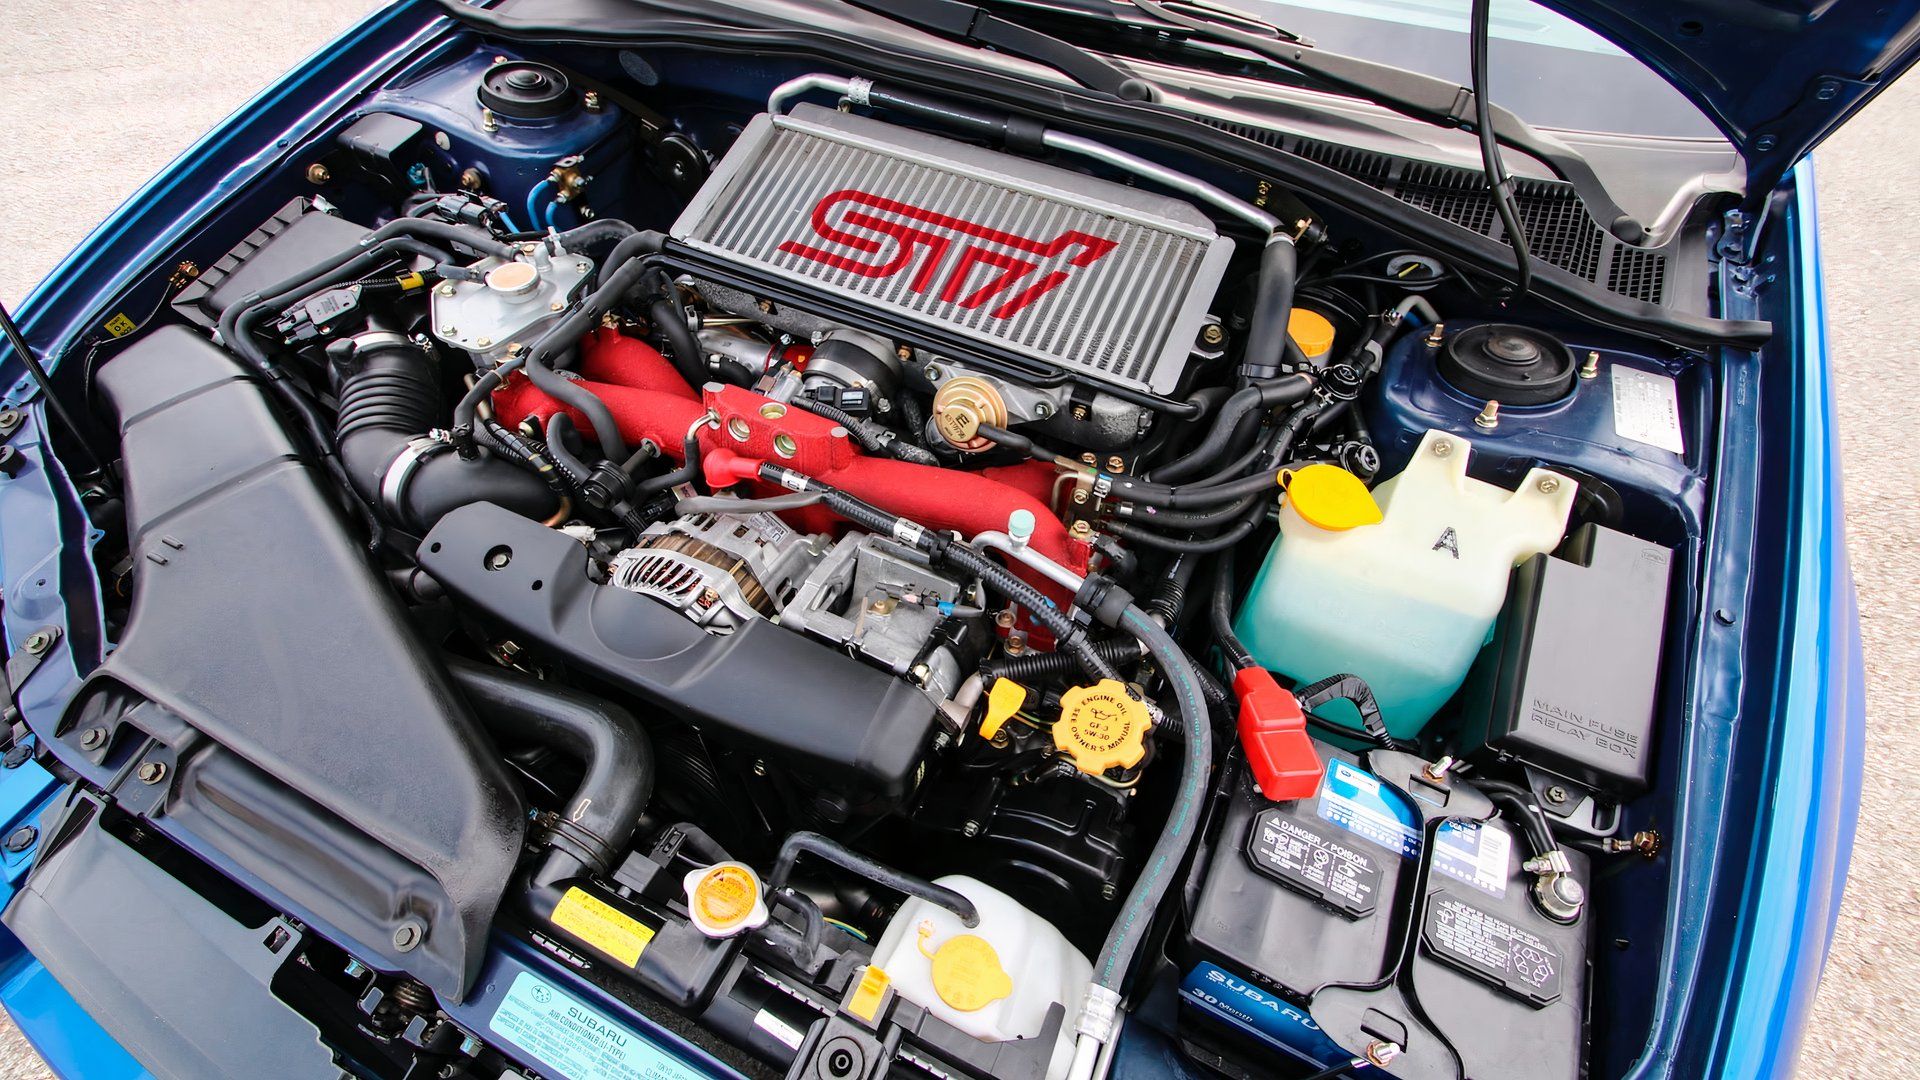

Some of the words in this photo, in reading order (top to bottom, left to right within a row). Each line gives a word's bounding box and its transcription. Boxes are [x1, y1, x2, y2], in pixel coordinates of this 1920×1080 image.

[1431, 526, 1460, 560] A
[1070, 707, 1081, 723] SEE
[1081, 694, 1116, 706] ENGINE
[1116, 702, 1128, 716] OIL
[1533, 697, 1583, 724] MAIN
[1588, 718, 1638, 744] FUSE
[1070, 726, 1106, 752] OWNERS
[1107, 721, 1132, 750] MANUAL
[1531, 712, 1586, 741] RELAY
[1595, 736, 1636, 760] BOX
[1280, 820, 1322, 845] DANGER
[1330, 843, 1368, 868] POISON
[1192, 988, 1218, 1004] 30
[1207, 970, 1320, 1031] SUBARU
[548, 1009, 561, 1021] AIR
[567, 1006, 628, 1047] SUBARU
